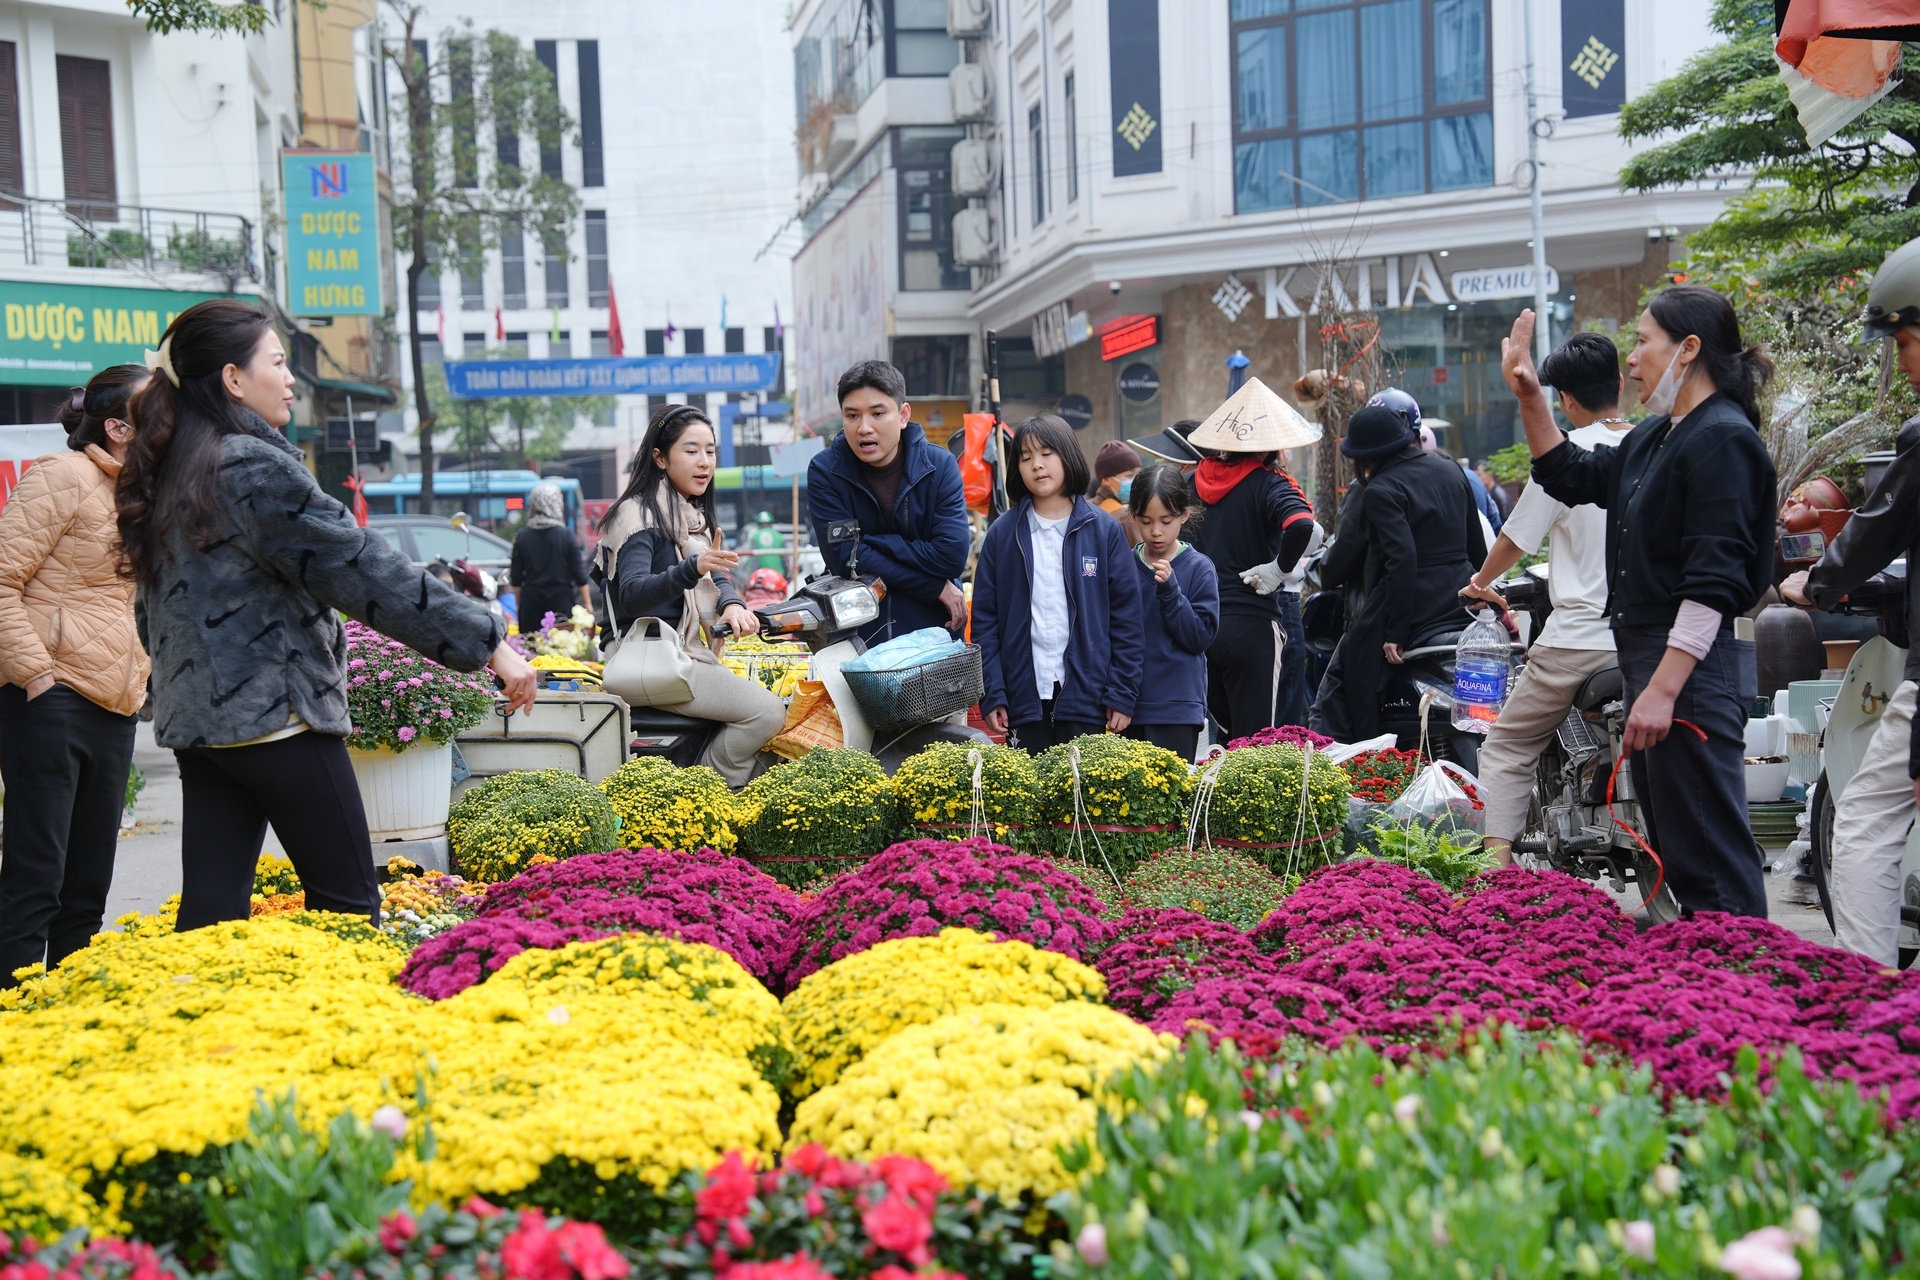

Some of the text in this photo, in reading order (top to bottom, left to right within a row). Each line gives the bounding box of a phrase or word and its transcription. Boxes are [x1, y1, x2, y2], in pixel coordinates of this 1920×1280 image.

[302, 211, 361, 239] DƯỢC
[307, 249, 359, 271] NAM
[304, 283, 365, 308] HƯNG
[5, 302, 85, 349] DƯỢC
[92, 308, 159, 346] NAM
[1457, 679, 1493, 693] AQUAFINA
